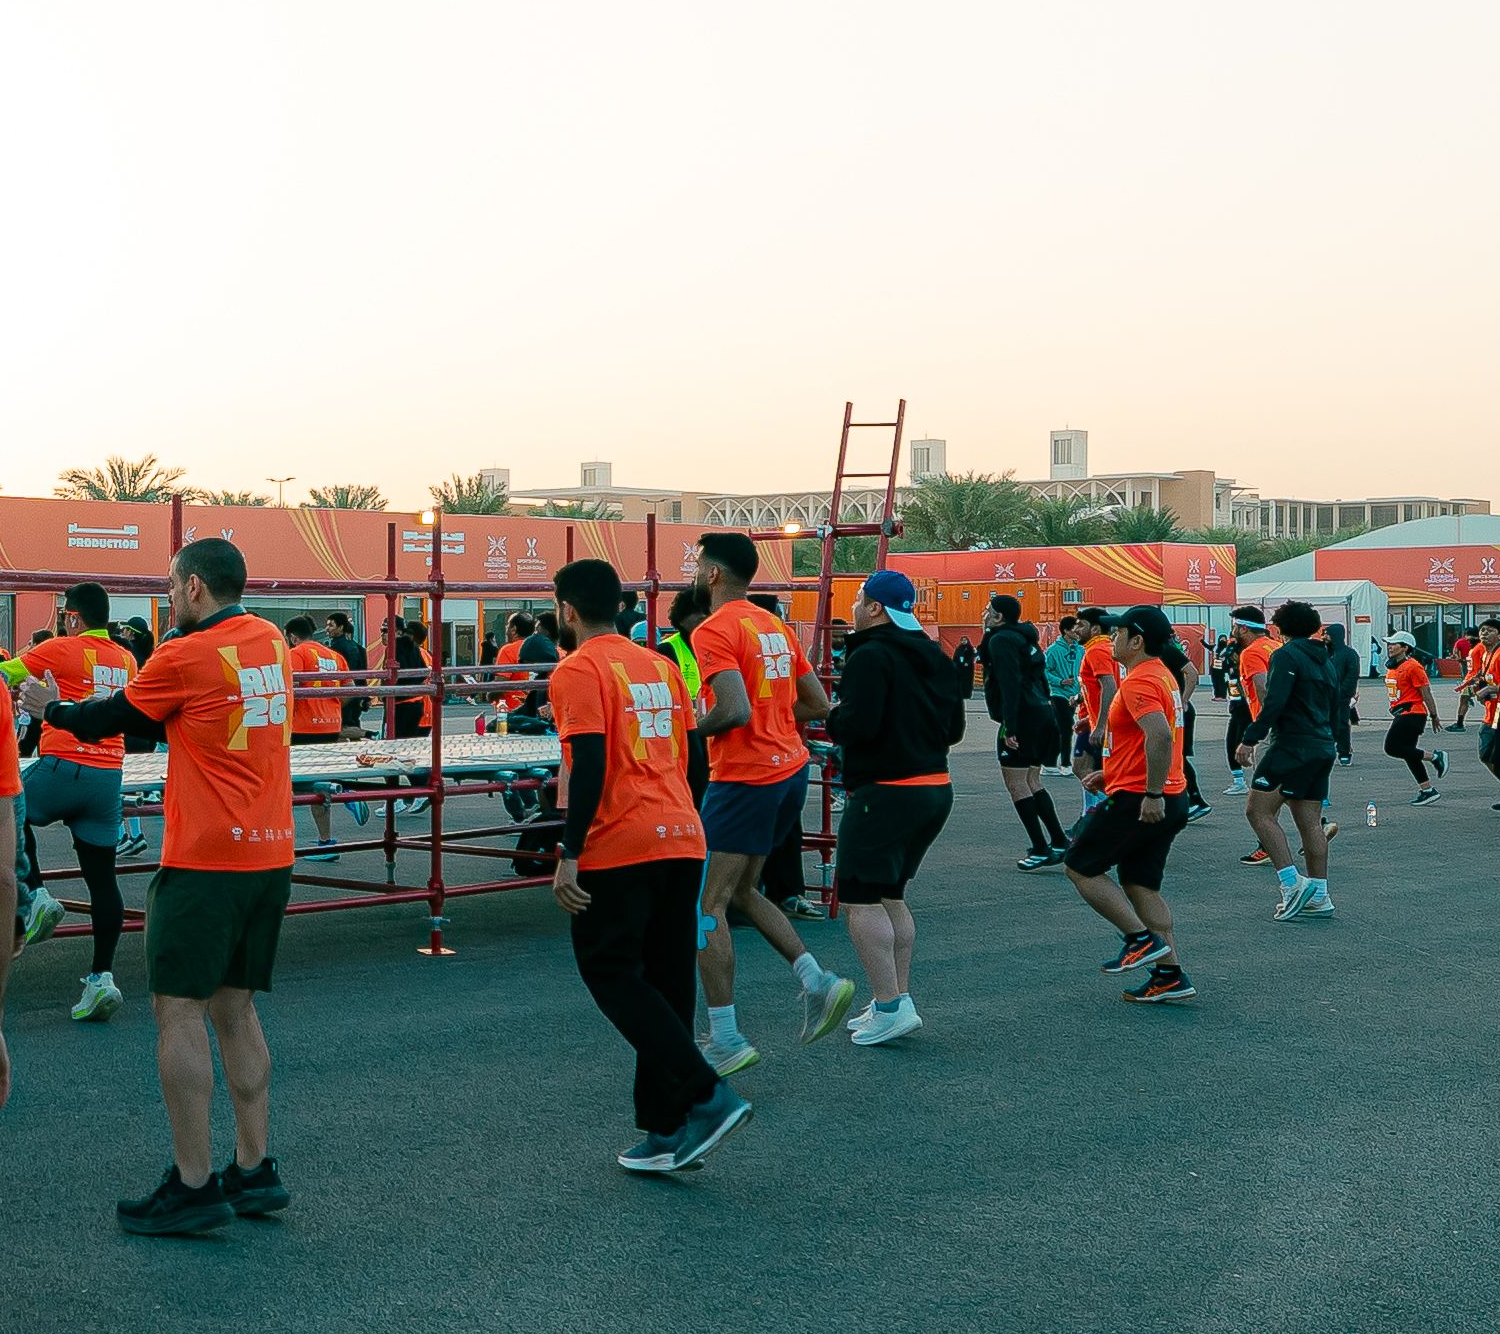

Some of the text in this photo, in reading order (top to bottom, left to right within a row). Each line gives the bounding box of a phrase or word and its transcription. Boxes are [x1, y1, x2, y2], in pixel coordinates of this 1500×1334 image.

[68, 536, 139, 551] PRODUCTION
[93, 665, 128, 687] RM
[236, 663, 286, 698] RM
[763, 654, 792, 679] 26
[628, 681, 673, 710] RM
[242, 693, 288, 728] 26
[636, 709, 673, 739] 26
